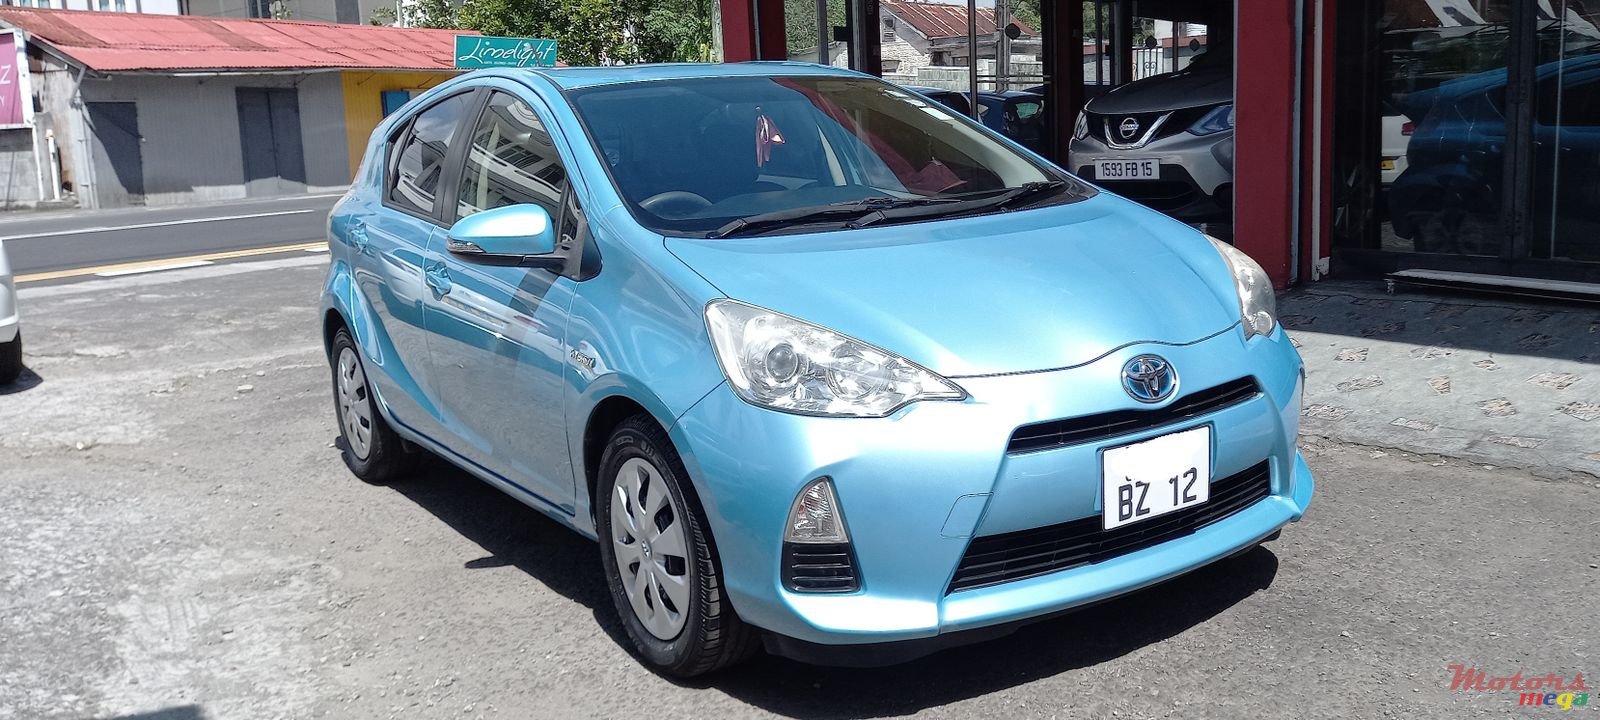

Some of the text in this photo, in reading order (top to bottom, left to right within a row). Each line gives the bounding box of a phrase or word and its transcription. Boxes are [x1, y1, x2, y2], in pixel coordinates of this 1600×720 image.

[458, 38, 555, 67] Limelight
[1101, 161, 1152, 177] 1593 FB 15
[1118, 466, 1198, 522] BZ 12
